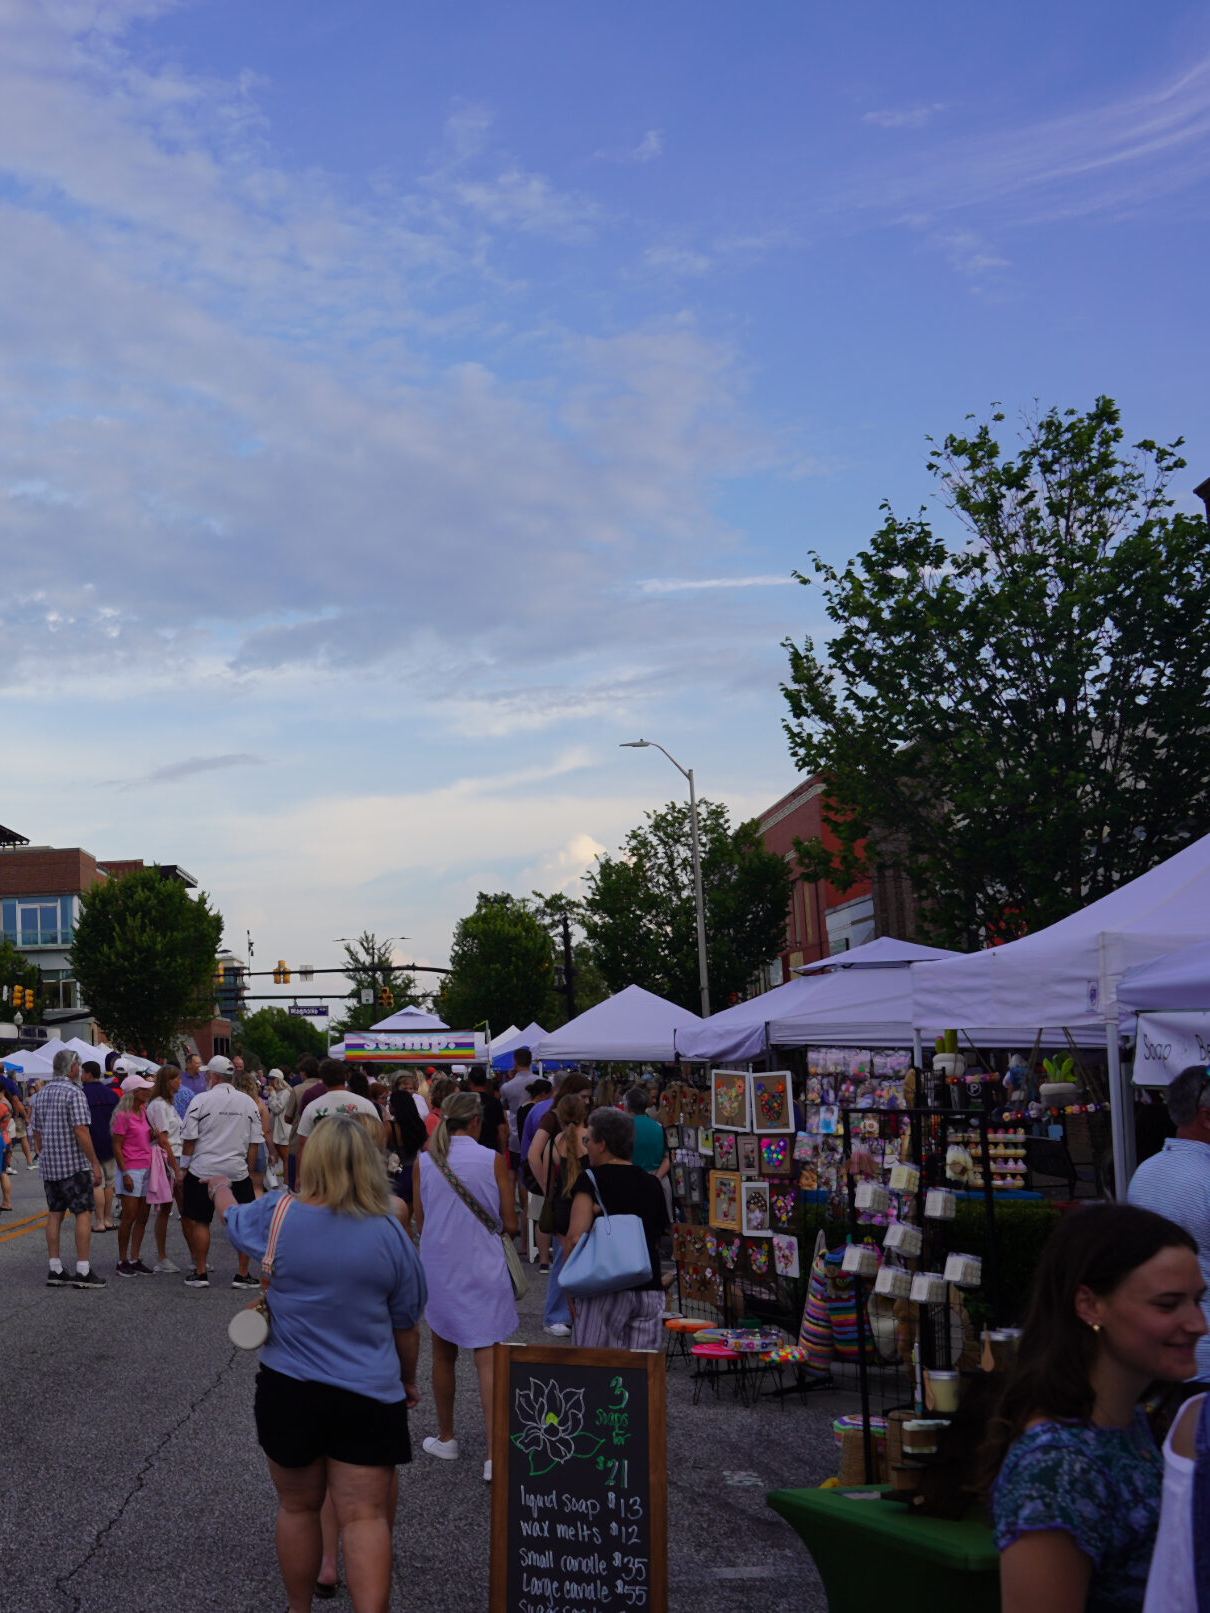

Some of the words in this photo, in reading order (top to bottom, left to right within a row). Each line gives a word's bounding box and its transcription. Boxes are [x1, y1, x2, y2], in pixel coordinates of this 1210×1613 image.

[608, 1375, 630, 1410] 3
[556, 1520, 602, 1544] melts
[563, 1579, 612, 1604] candle
